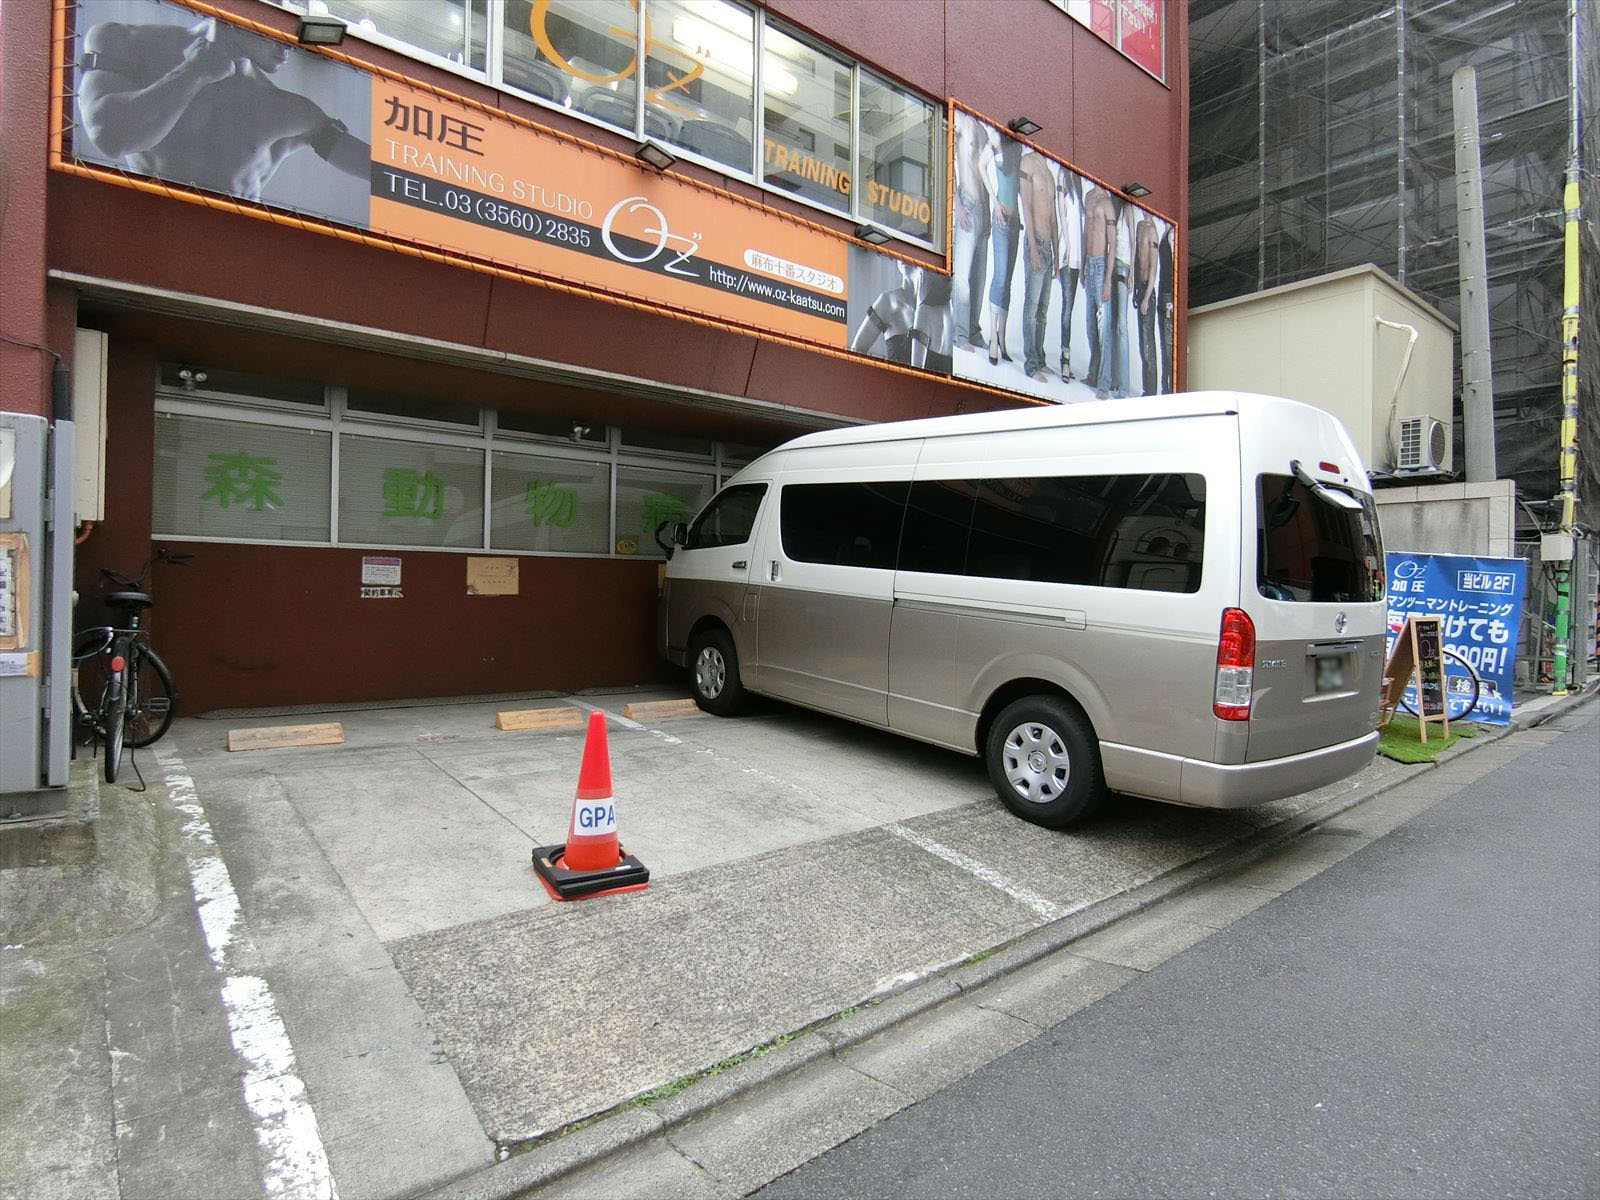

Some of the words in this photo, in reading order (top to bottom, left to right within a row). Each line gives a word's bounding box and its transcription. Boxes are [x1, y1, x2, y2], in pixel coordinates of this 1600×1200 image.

[384, 96, 485, 157] 加圧
[385, 139, 505, 193] TRAINING
[512, 180, 593, 219] STUDIO
[764, 139, 851, 194] TRAINING
[867, 180, 931, 224] STUDIO
[709, 265, 845, 318] http://www.oz-kaatsu.com
[751, 252, 837, 291] 麻布十番スタジオ
[1387, 595, 1514, 617] マンツーマントレーニング
[579, 804, 616, 828] GPA
